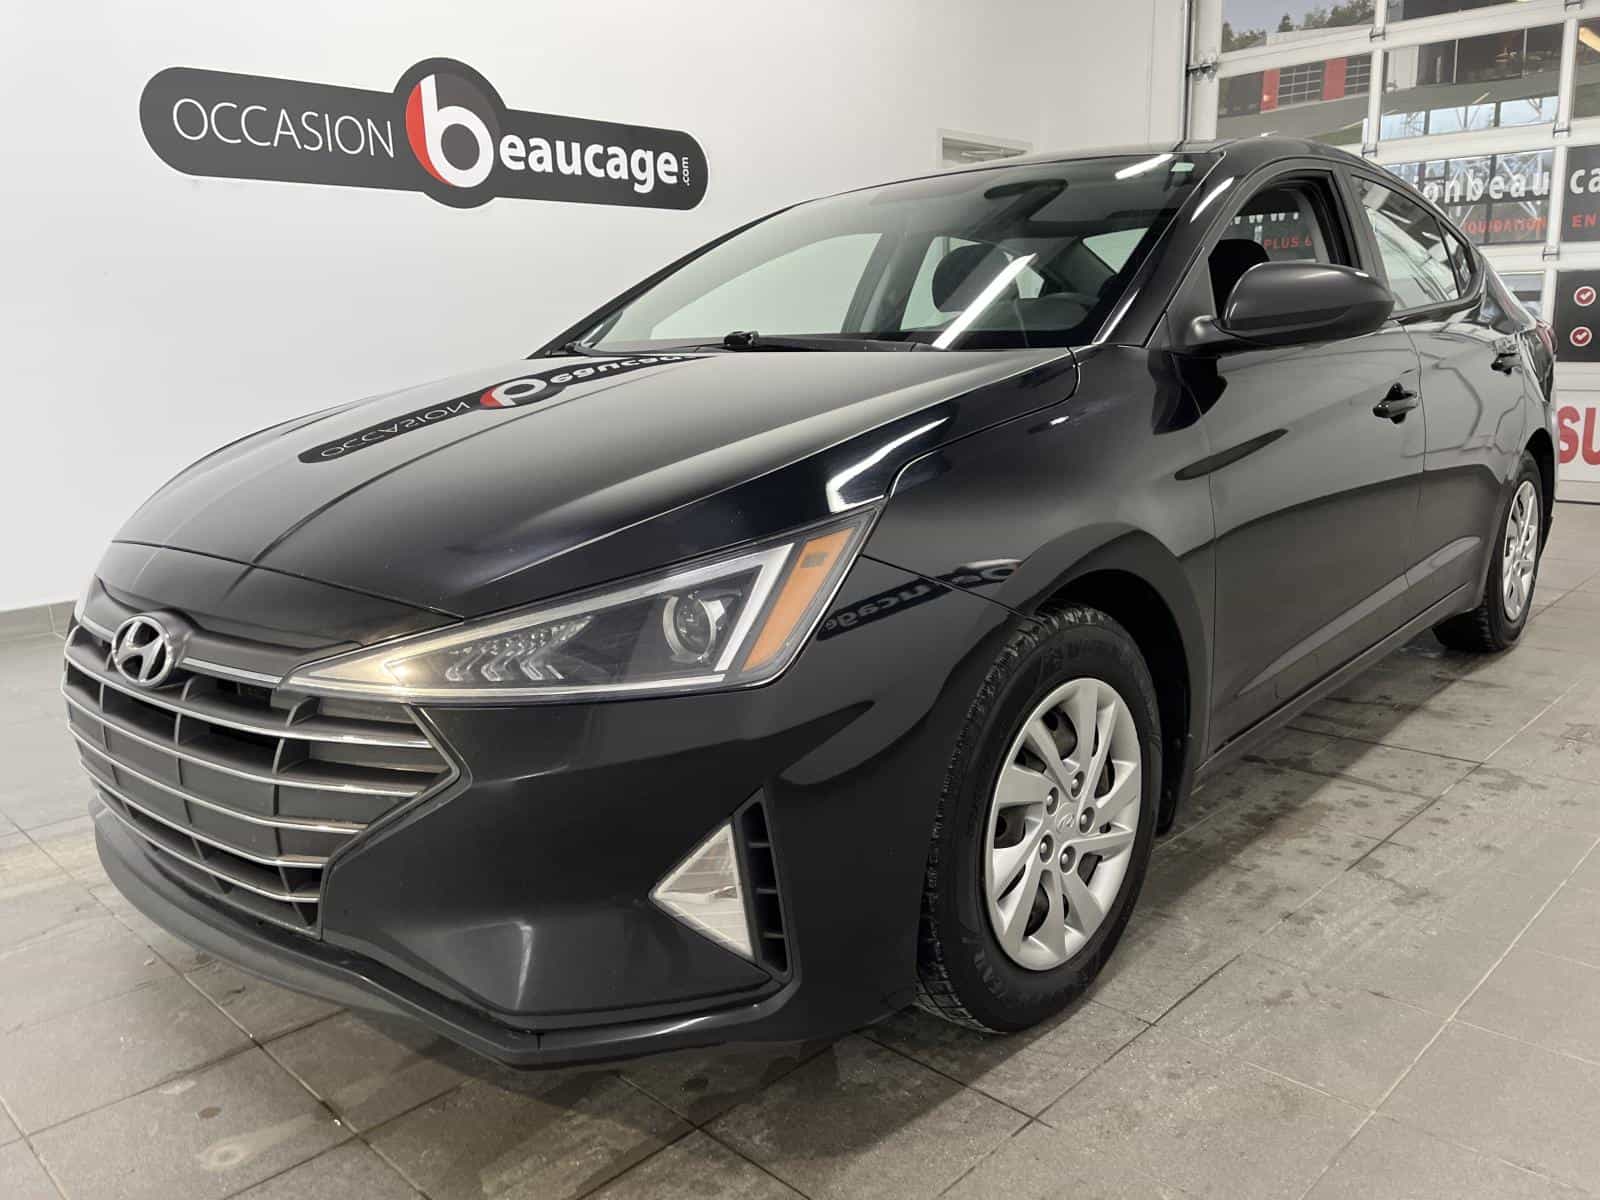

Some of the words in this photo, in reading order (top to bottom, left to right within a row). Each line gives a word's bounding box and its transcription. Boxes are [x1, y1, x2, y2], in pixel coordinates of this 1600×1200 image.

[173, 98, 394, 158] OCCASION
[681, 156, 691, 187] .com
[1571, 213, 1597, 229] EN
[1263, 235, 1299, 250] PLUS
